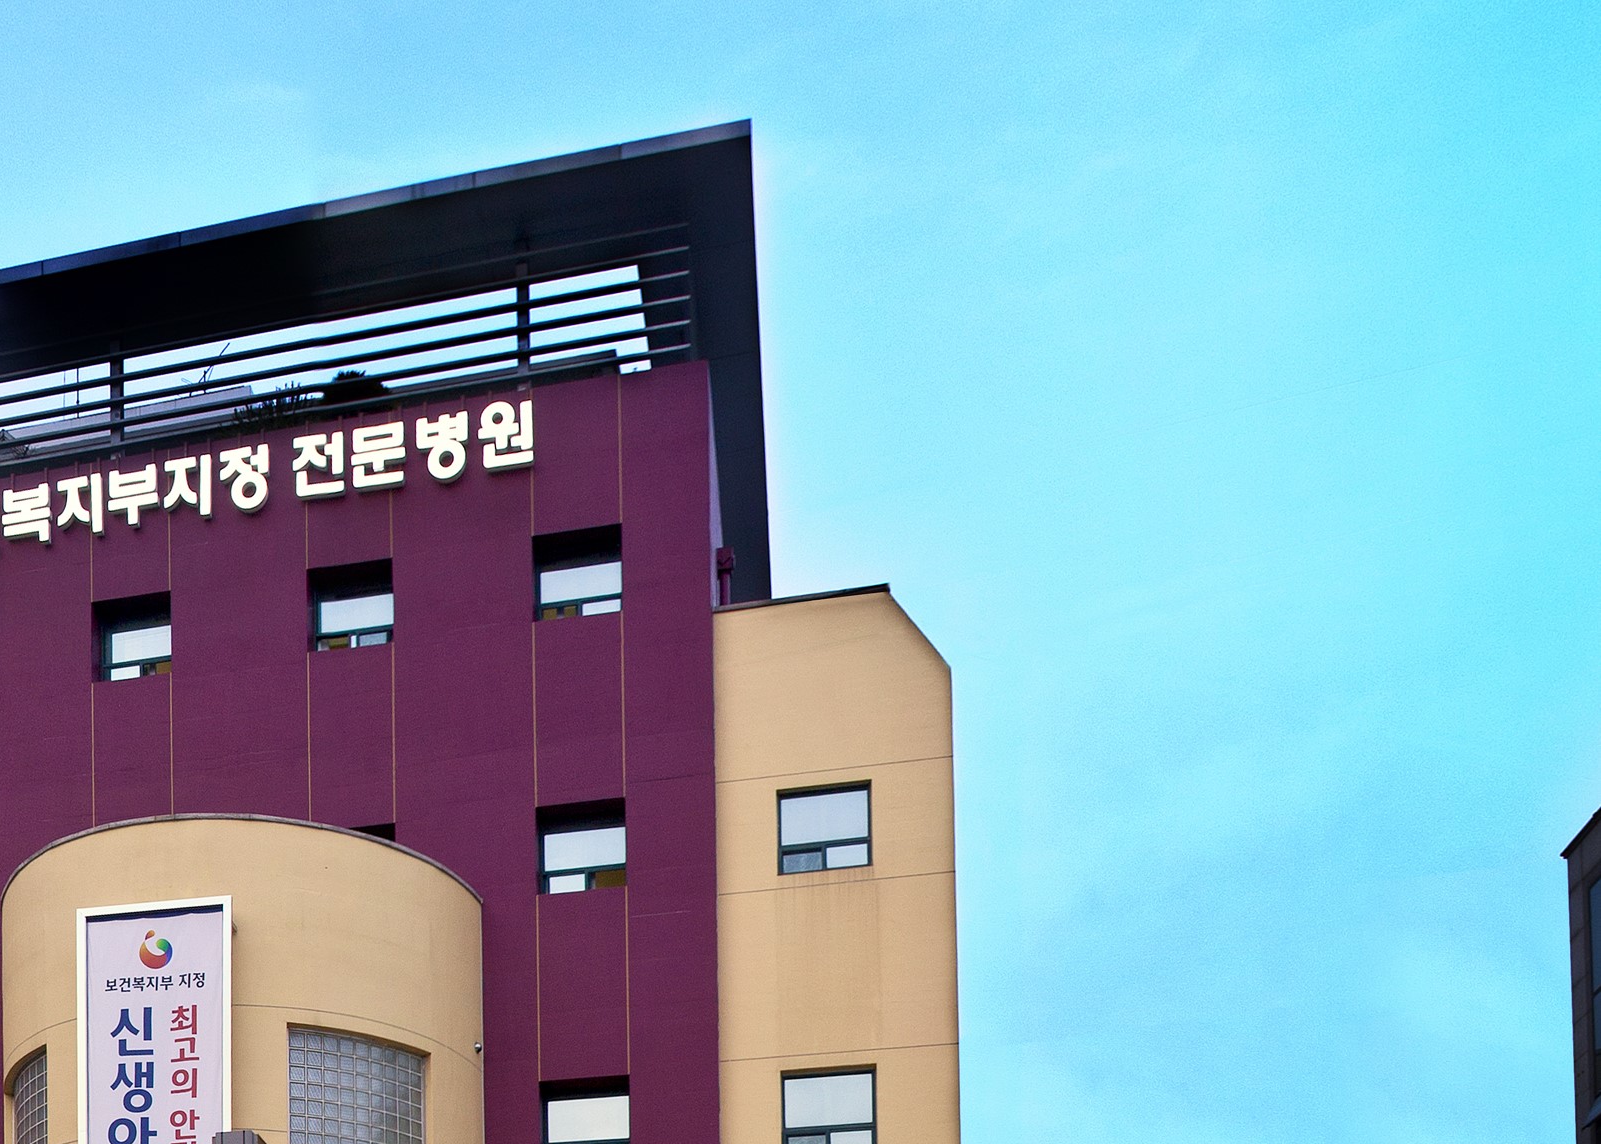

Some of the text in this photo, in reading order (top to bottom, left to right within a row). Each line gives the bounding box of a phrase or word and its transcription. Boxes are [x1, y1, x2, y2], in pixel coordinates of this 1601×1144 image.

[291, 399, 535, 500] 전문병원
[104, 971, 206, 993] 보건복지부 지정
[169, 1003, 201, 1099] 최고의
